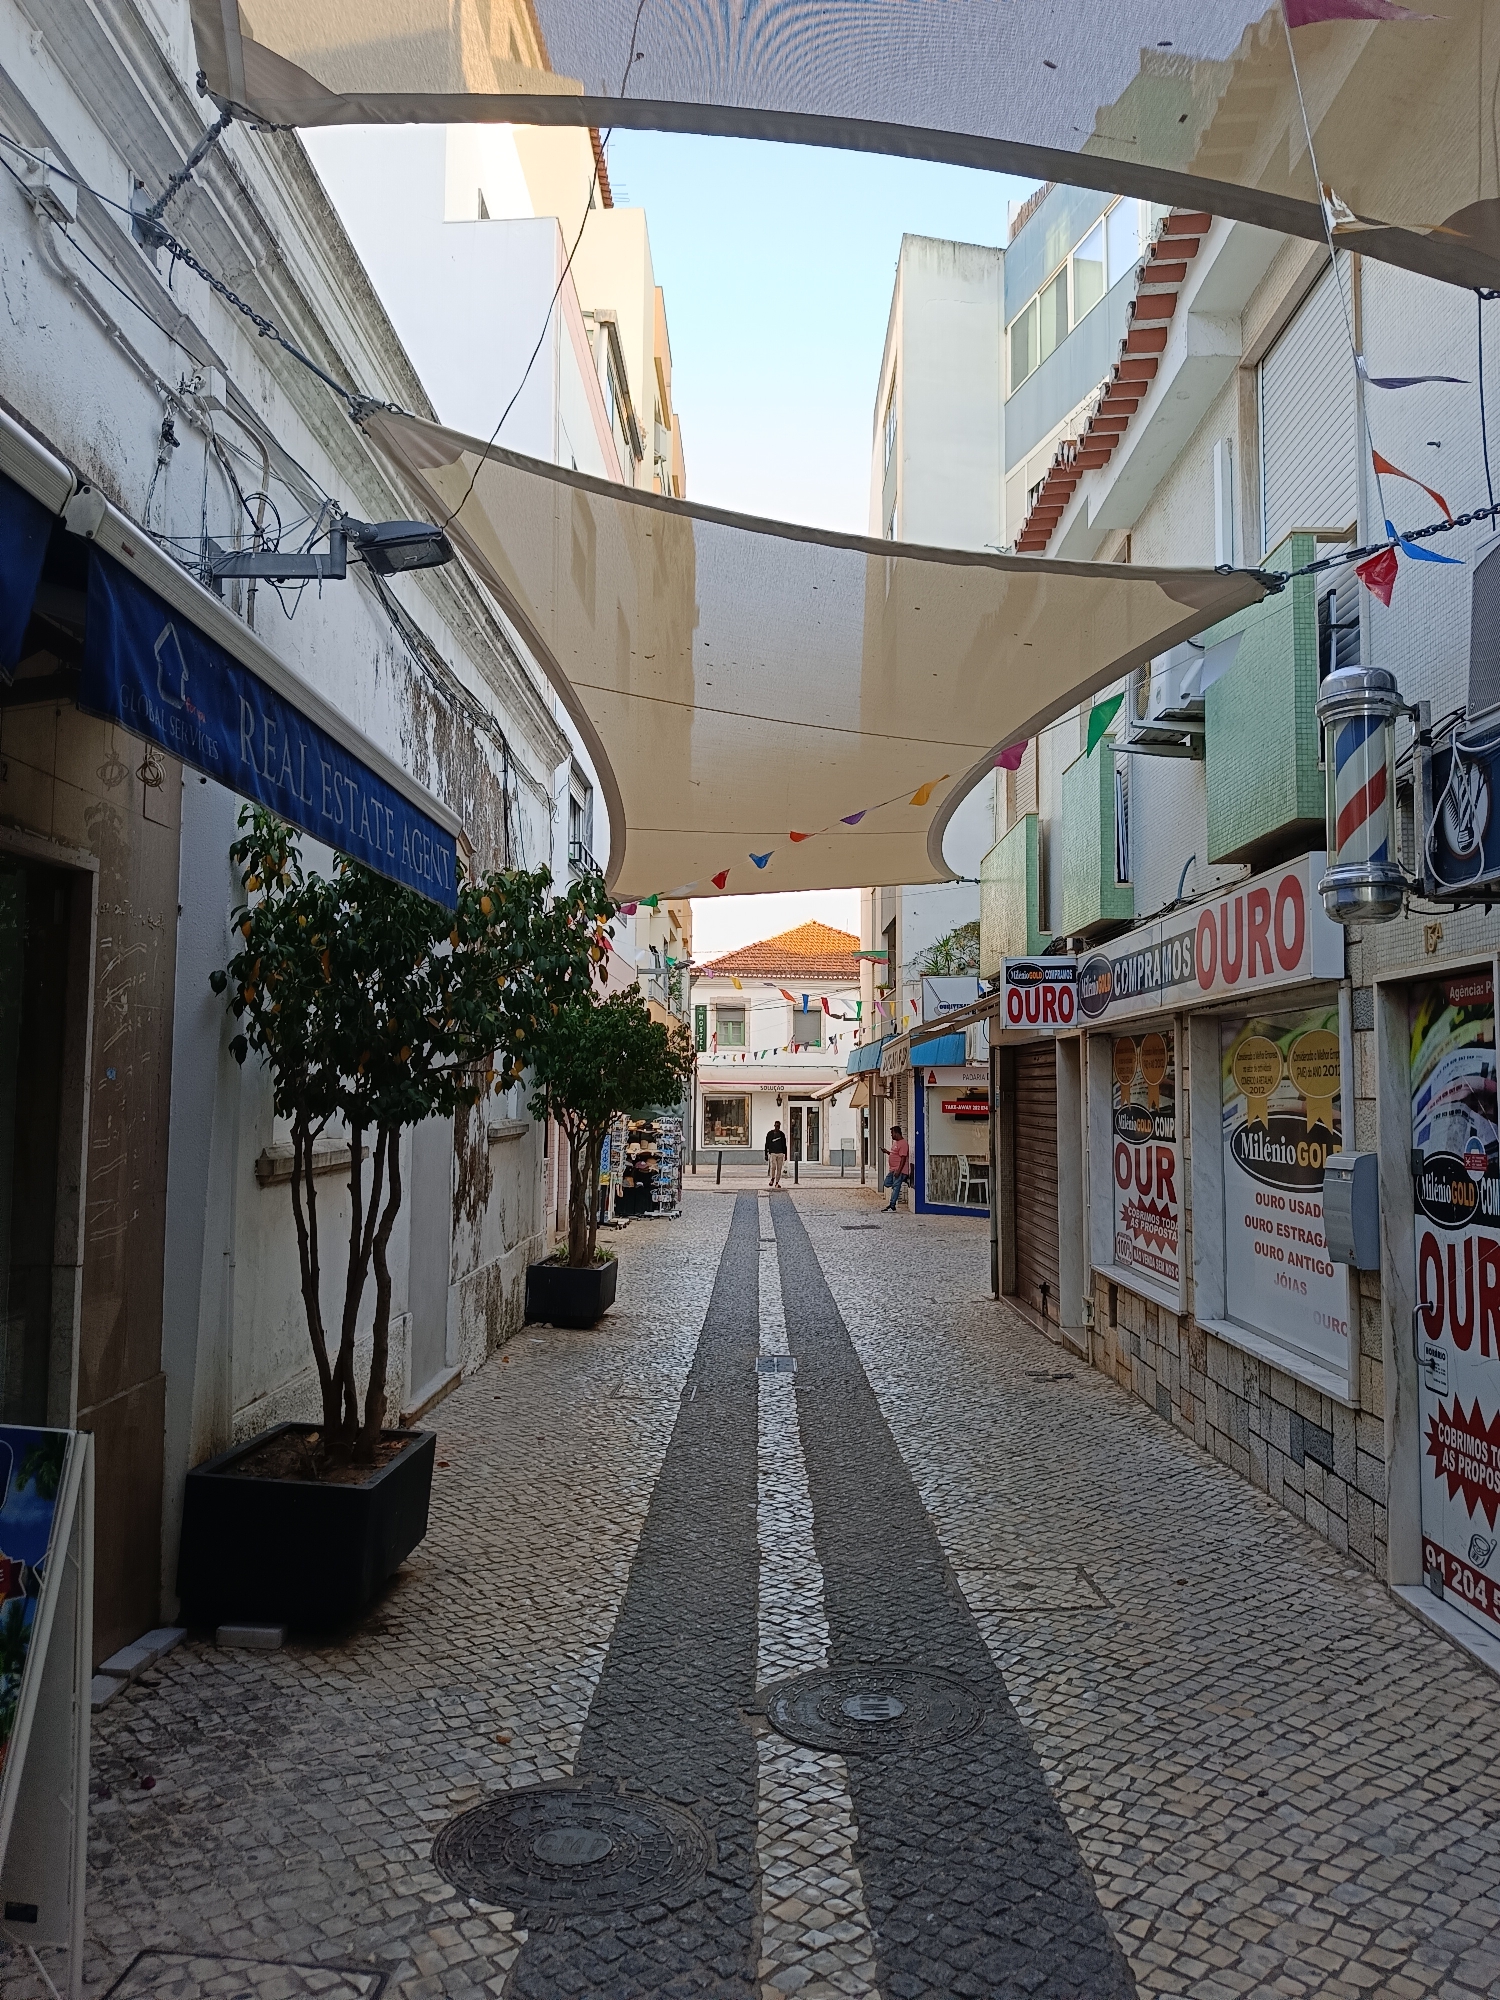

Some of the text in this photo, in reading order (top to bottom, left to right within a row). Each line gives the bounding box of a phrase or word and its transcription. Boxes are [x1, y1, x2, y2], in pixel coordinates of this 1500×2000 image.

[120, 683, 219, 760] GLOBAL SERVICES
[239, 694, 451, 890] REAL ESTATE AGENT
[1114, 874, 1305, 996] COMPRAMOS OURO
[1045, 969, 1073, 980] COMPRAMOS
[1450, 982, 1484, 1001] Agência:
[1007, 985, 1074, 1024] OURO
[1293, 1050, 1313, 1062] Considerado
[1317, 1048, 1329, 1060] Melhor
[962, 1073, 986, 1081] PADARIA
[1313, 1065, 1321, 1077] ANO
[1249, 1086, 1265, 1094] 2012
[1115, 1142, 1177, 1204] OUR
[1127, 1206, 1160, 1225] COBRIMOS
[1255, 1192, 1324, 1219] OURO USAD
[1130, 1217, 1140, 1229] AS
[1244, 1214, 1274, 1234] OURO
[1142, 1252, 1156, 1269] VENDA
[1156, 1258, 1165, 1273] SEM
[1254, 1241, 1335, 1278] OURO ANTIGO
[1274, 1271, 1308, 1296] JÓIAS
[1419, 1231, 1500, 1361] OUR
[1425, 1346, 1446, 1361] HORÁRIO
[1438, 1422, 1488, 1466] COBRIMOS
[1442, 1447, 1500, 1494] AS PROPOS
[1425, 1544, 1446, 1580] 91
[1451, 1561, 1488, 1609] 204
